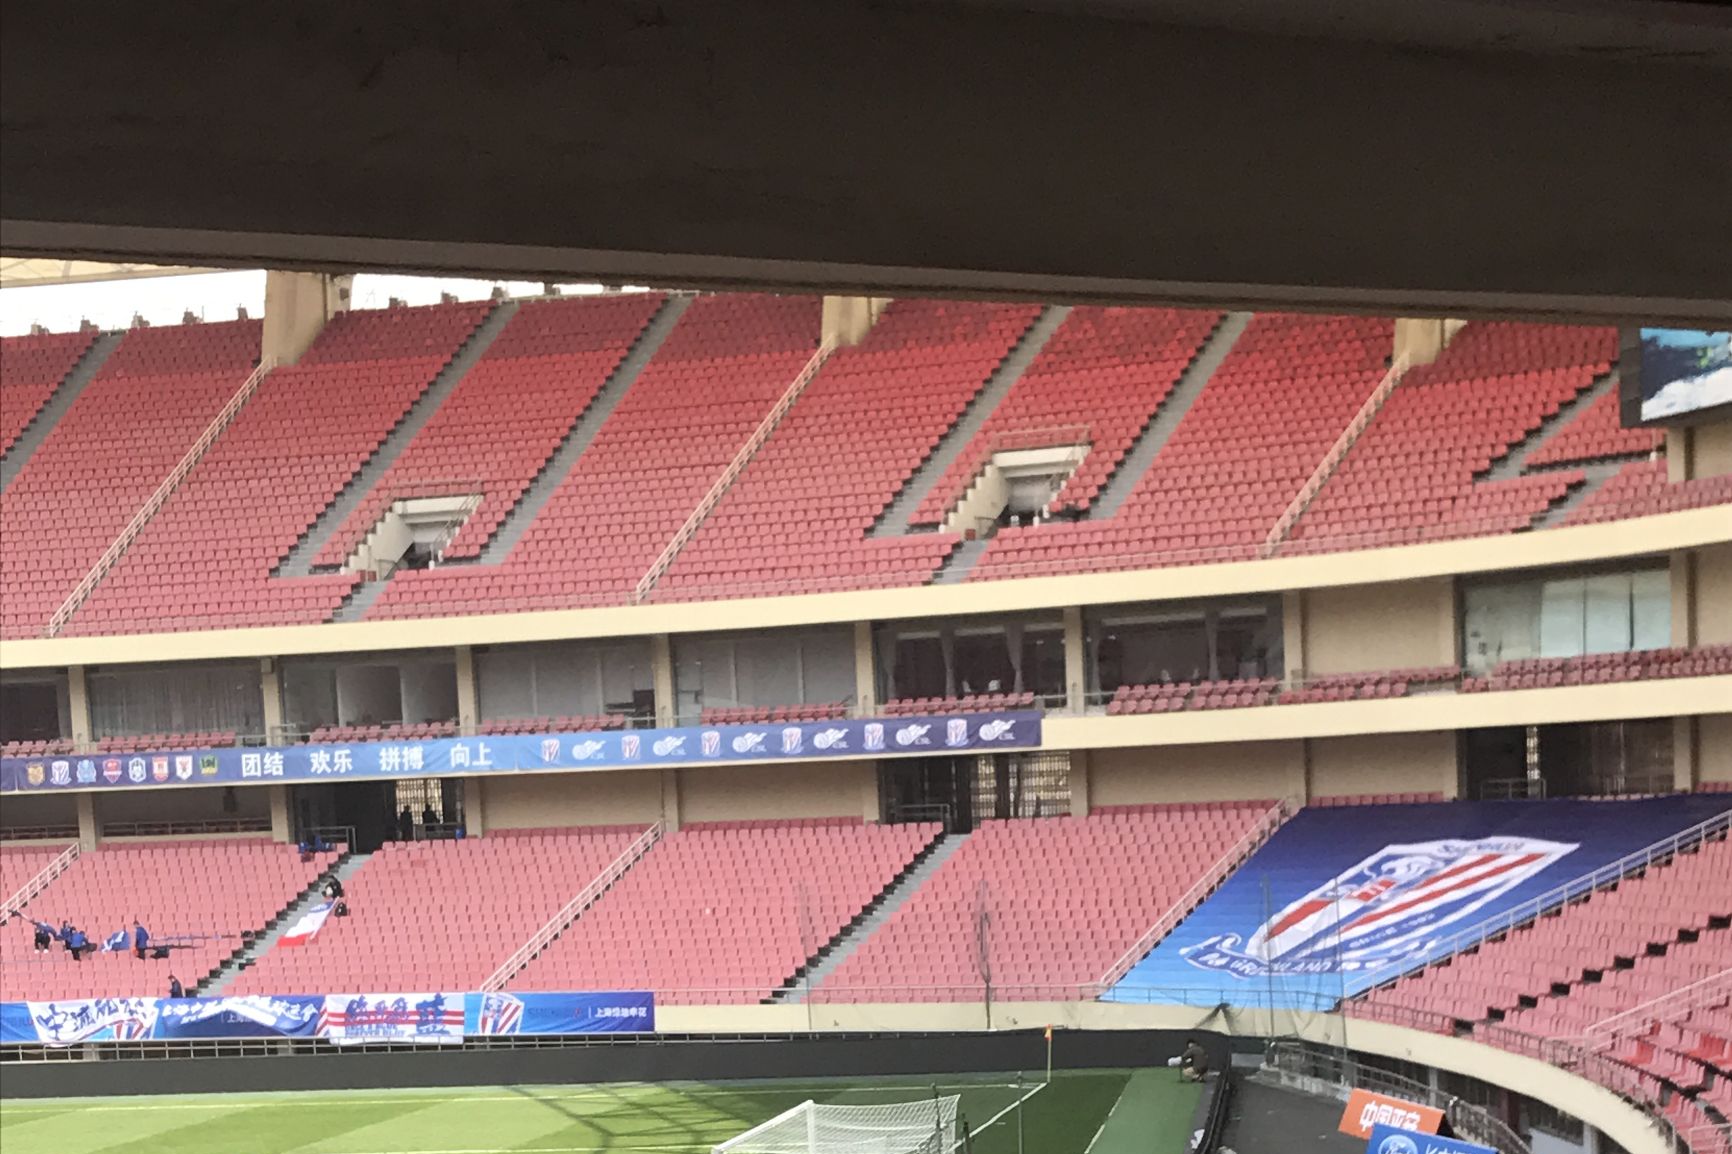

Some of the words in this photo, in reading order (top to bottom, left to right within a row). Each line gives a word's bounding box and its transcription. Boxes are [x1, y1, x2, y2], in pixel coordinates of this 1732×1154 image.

[242, 753, 284, 777] 团结
[310, 749, 352, 774] 欢乐
[379, 746, 425, 771] 拼搏
[449, 742, 493, 767] 向上
